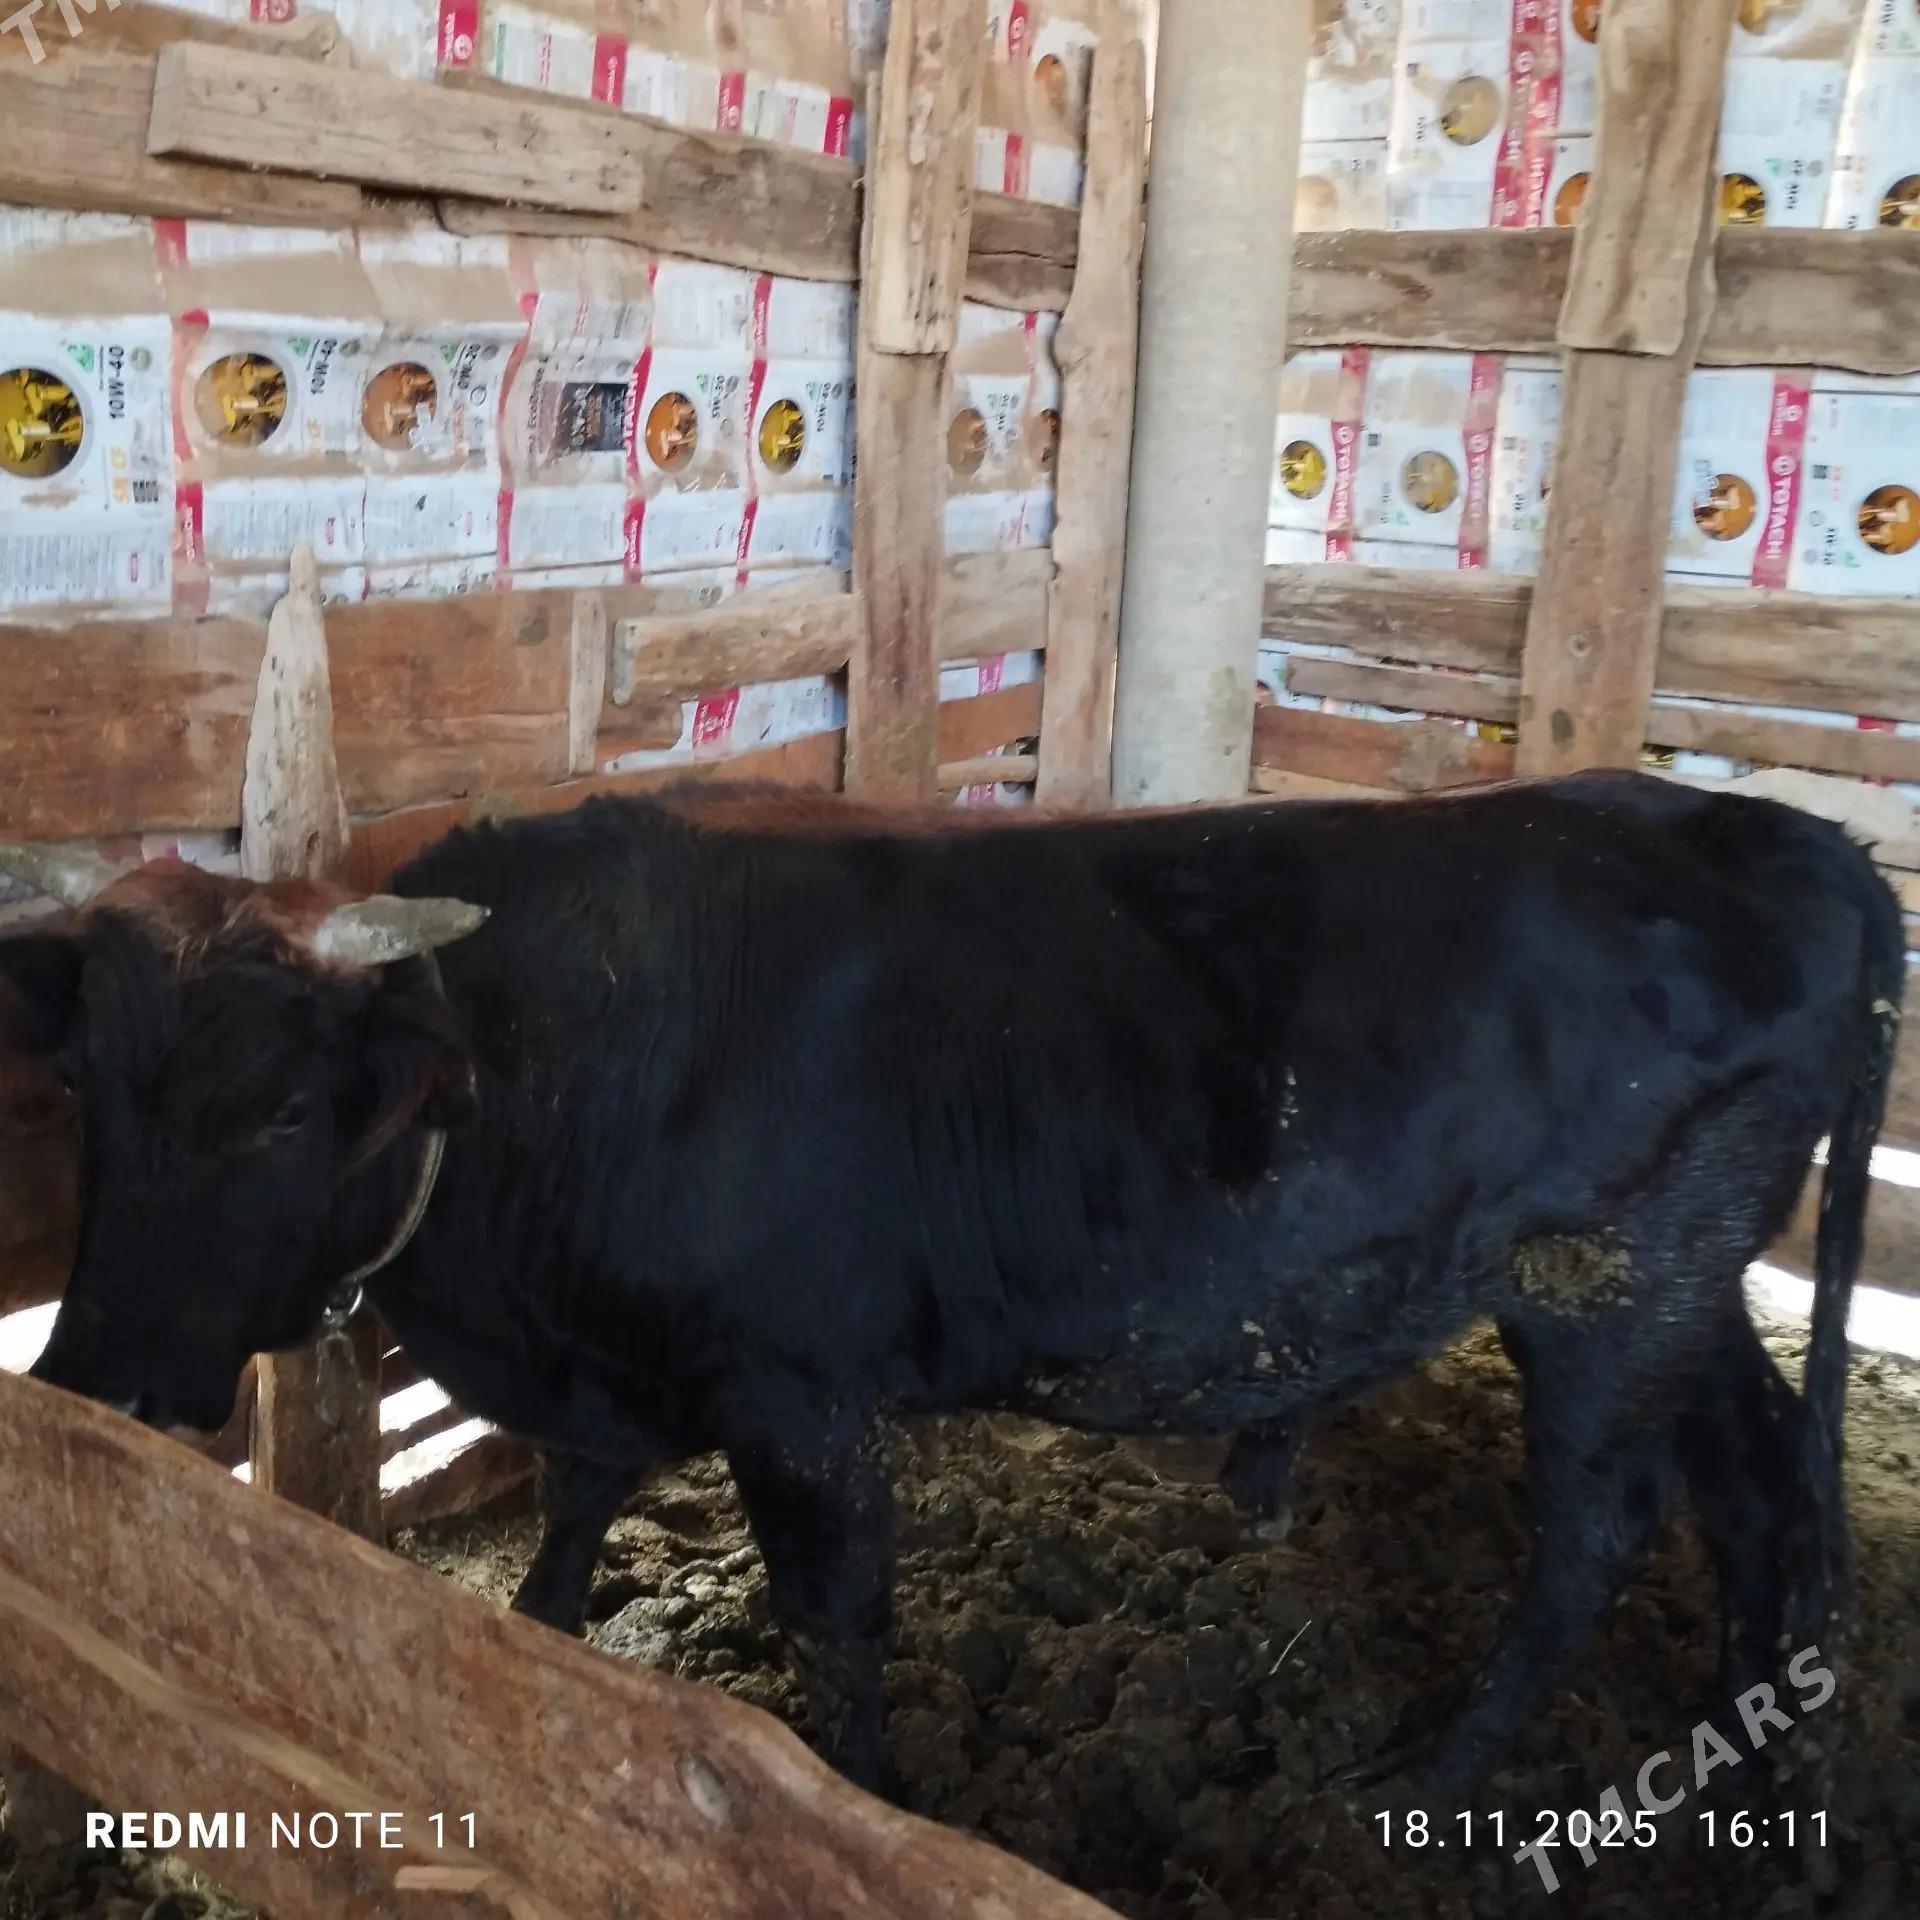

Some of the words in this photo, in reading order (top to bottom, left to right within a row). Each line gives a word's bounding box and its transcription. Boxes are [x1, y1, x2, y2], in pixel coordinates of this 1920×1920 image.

[107, 346, 125, 420] 10W-40
[311, 337, 337, 396] 10W-40
[1335, 446, 1352, 519] TOTACHI
[1766, 478, 1791, 560] TOTACHI
